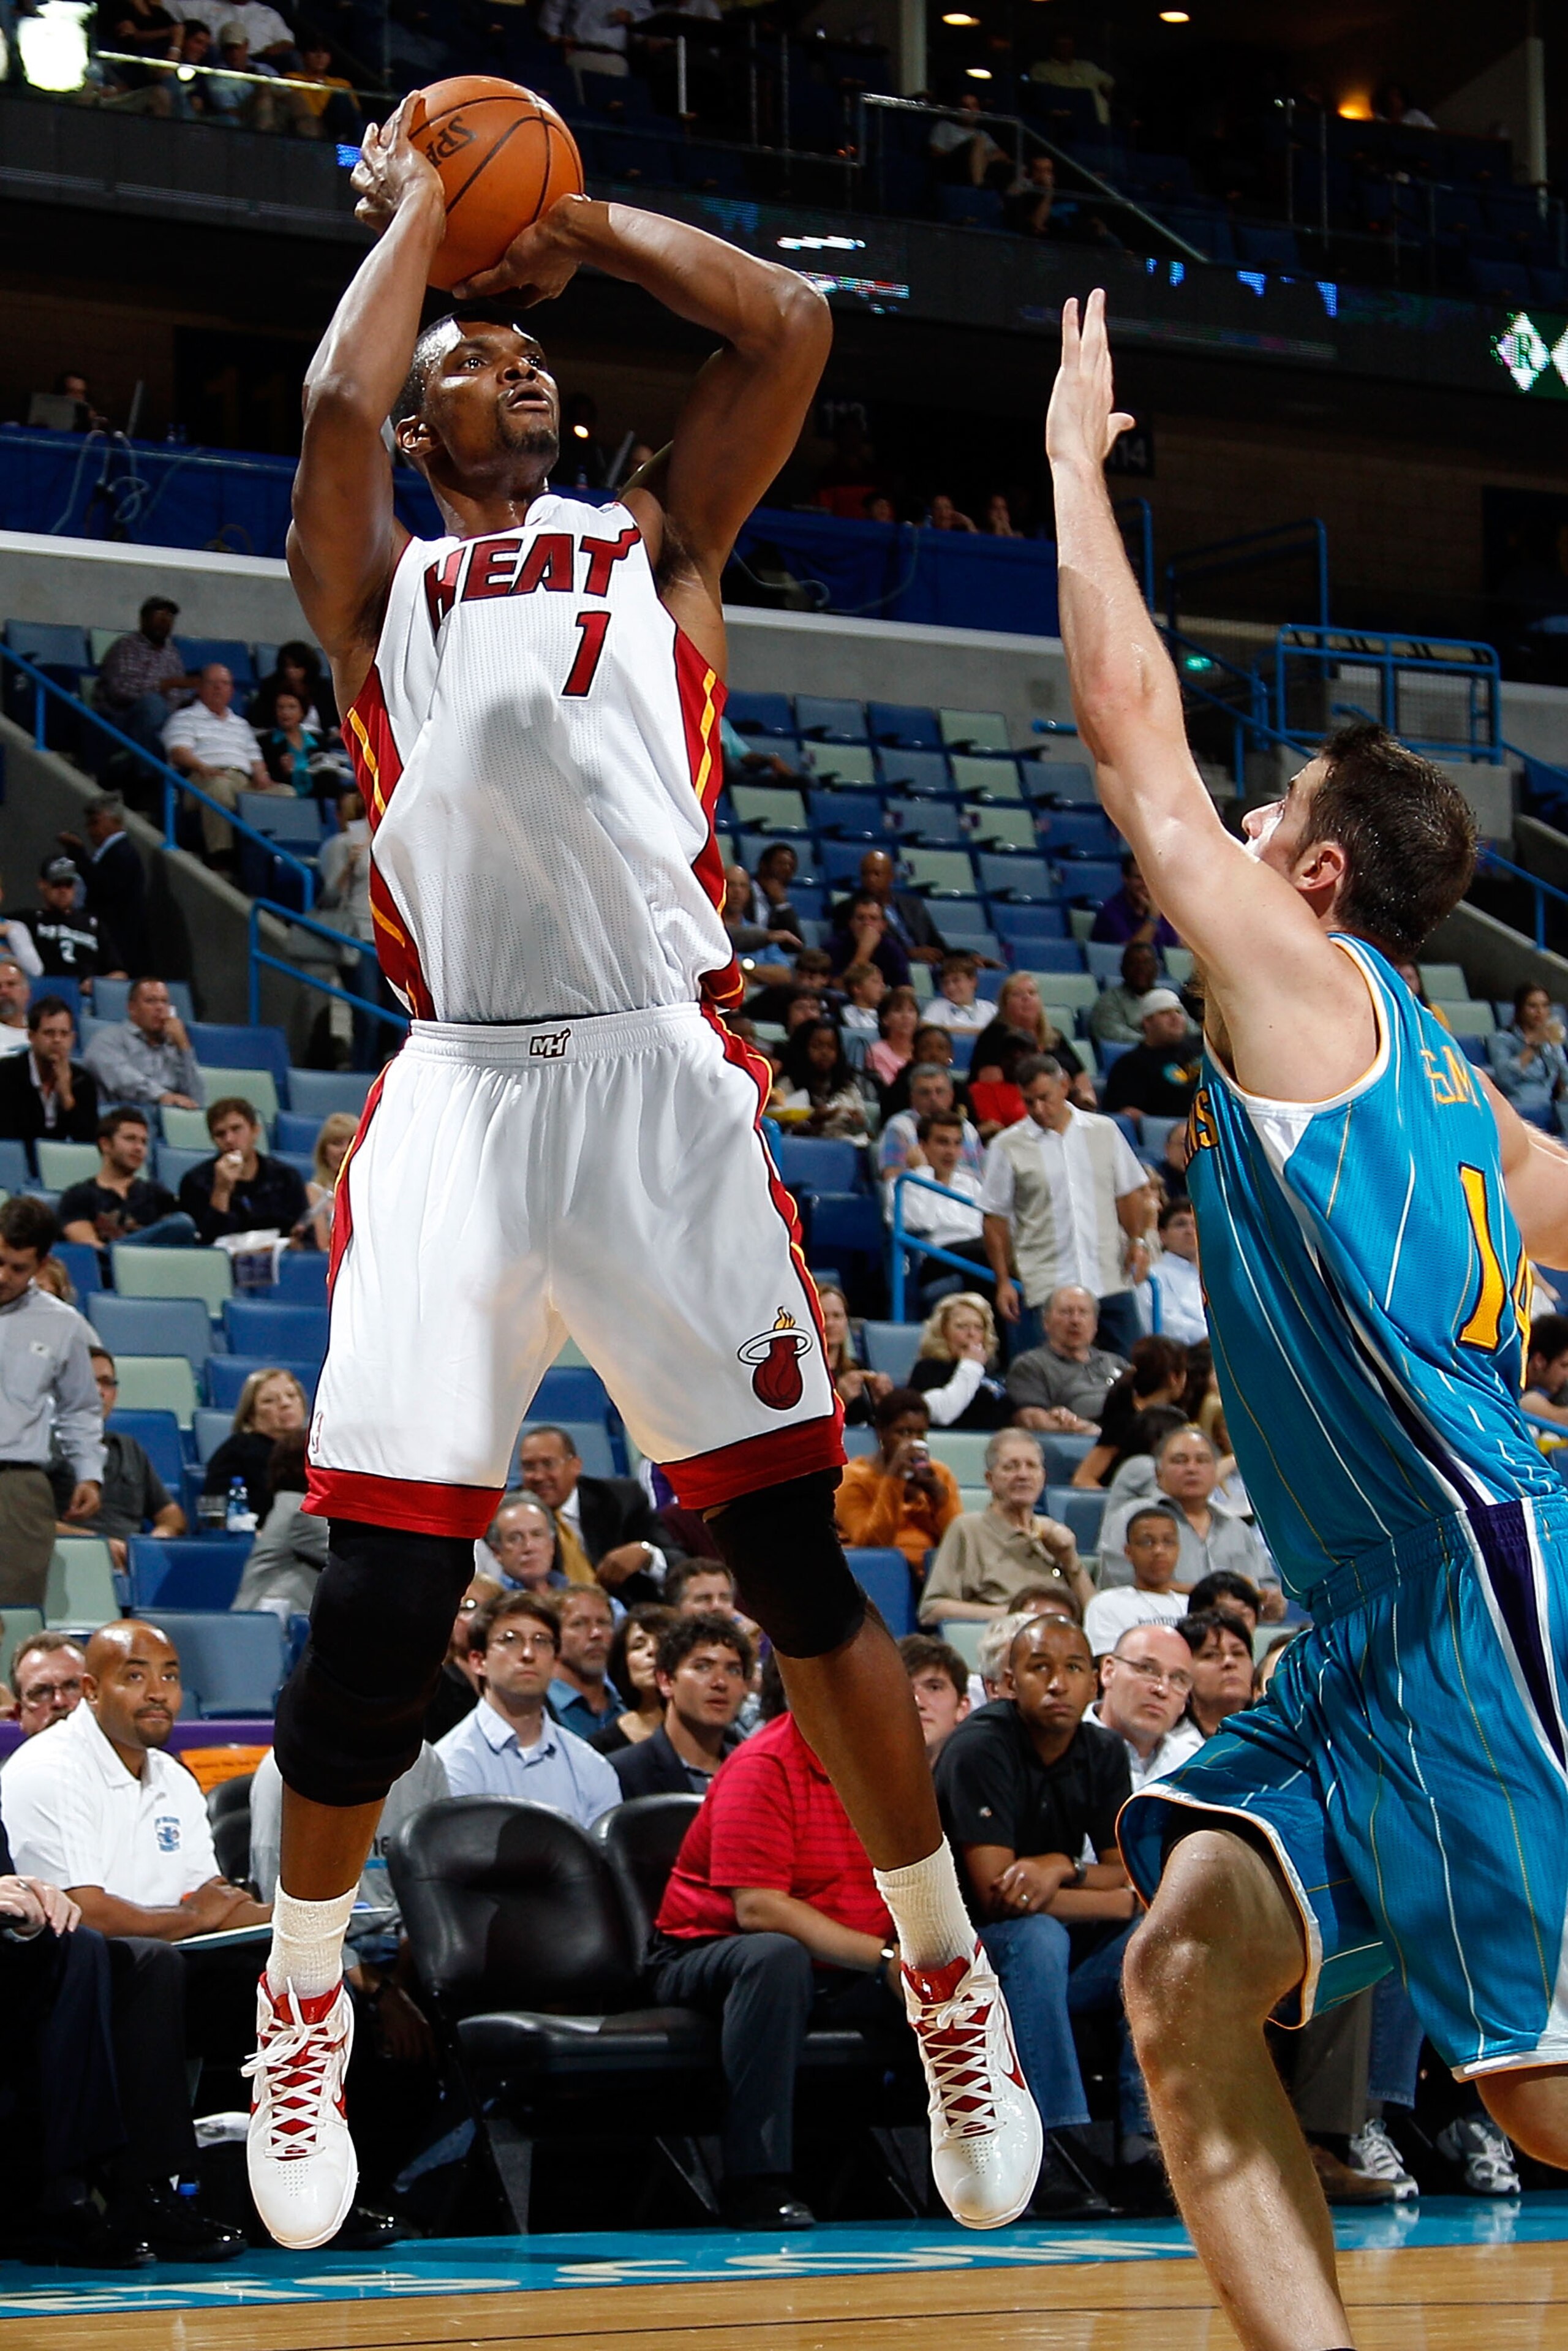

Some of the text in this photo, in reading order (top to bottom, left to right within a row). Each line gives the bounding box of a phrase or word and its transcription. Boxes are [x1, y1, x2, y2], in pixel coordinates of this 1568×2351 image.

[424, 523, 641, 640] HEAT
[560, 610, 612, 698] 1
[530, 1028, 571, 1059] MH
